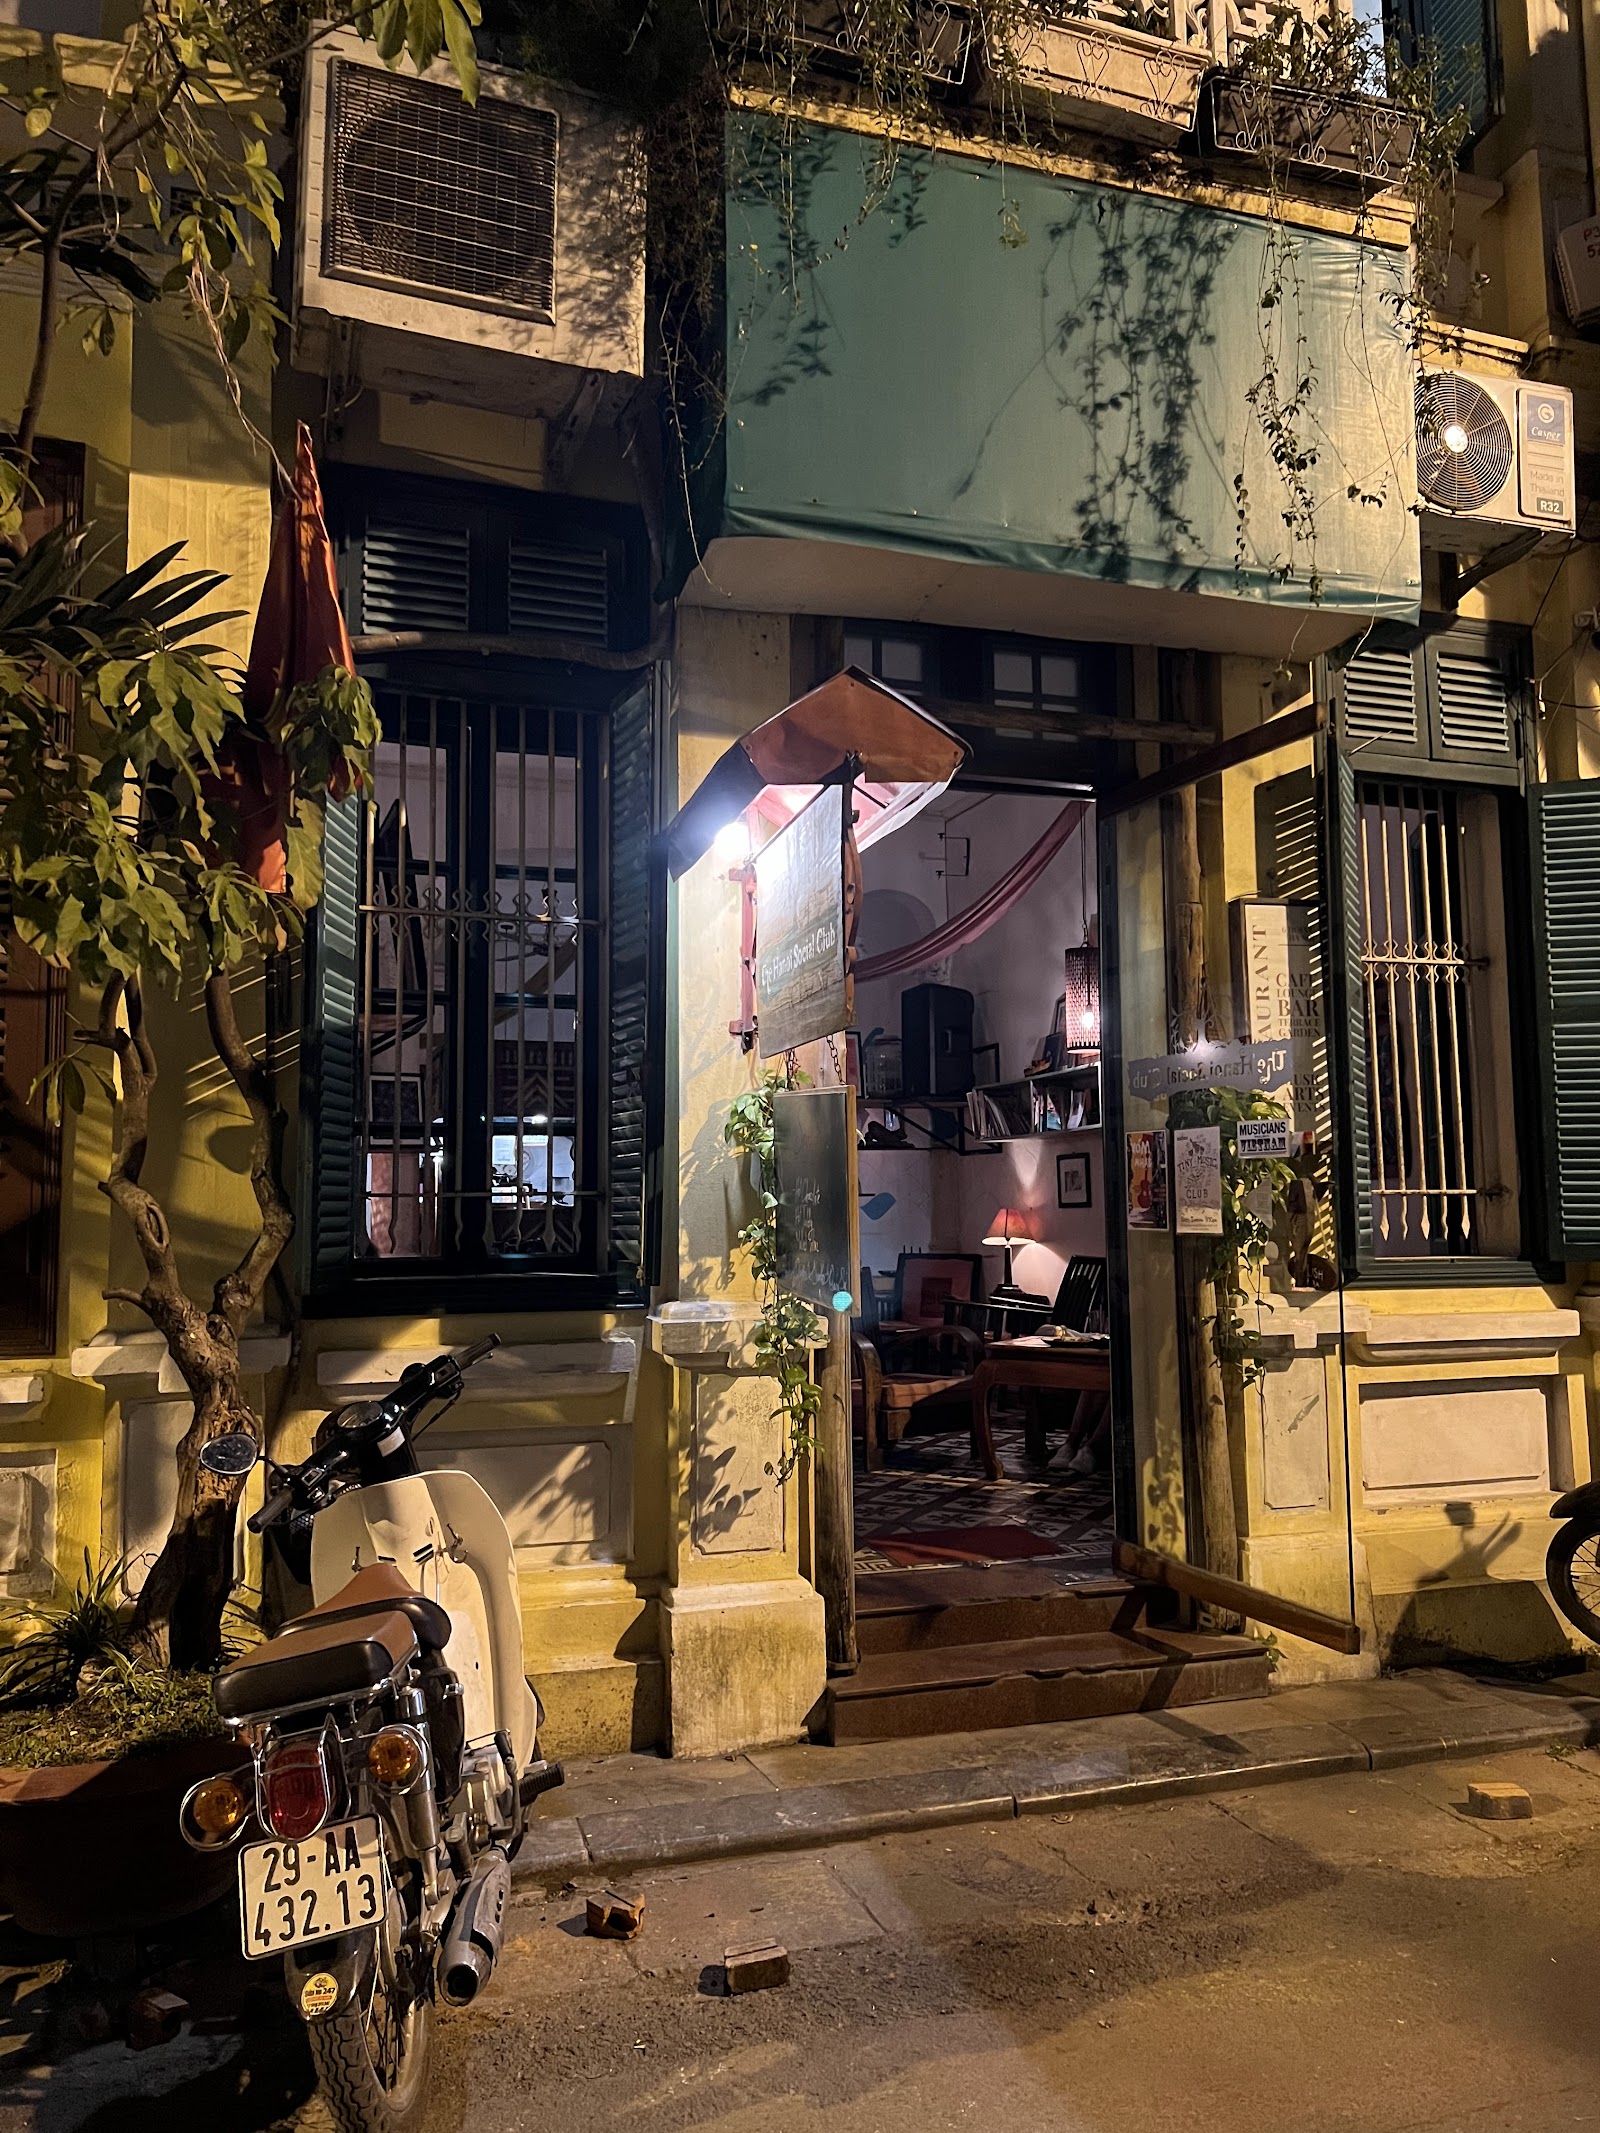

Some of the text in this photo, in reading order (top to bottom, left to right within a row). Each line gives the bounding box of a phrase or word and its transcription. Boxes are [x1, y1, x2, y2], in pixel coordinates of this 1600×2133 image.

[1587, 244, 1600, 258] 5
[1531, 426, 1561, 440] Casper
[1530, 470, 1564, 484] Made in
[1530, 483, 1565, 497] Thailand
[1540, 500, 1560, 513] R32
[793, 933, 815, 969] Social
[816, 922, 836, 954] Club
[1253, 925, 1273, 1041] AURANT
[1278, 999, 1320, 1017] BAR
[1279, 1018, 1321, 1027] TERRACE
[1278, 1028, 1321, 1038] GARDEN
[1290, 1073, 1322, 1086] USIC
[1283, 1086, 1325, 1101] ARTS
[1239, 1121, 1286, 1136] MUSICIANS
[1240, 1137, 1287, 1152] VIETNAM
[1177, 1157, 1193, 1172] TINY
[1185, 1188, 1209, 1199] CLUB
[262, 1826, 361, 1893] 29-AA
[254, 1874, 377, 1946] 432.13
